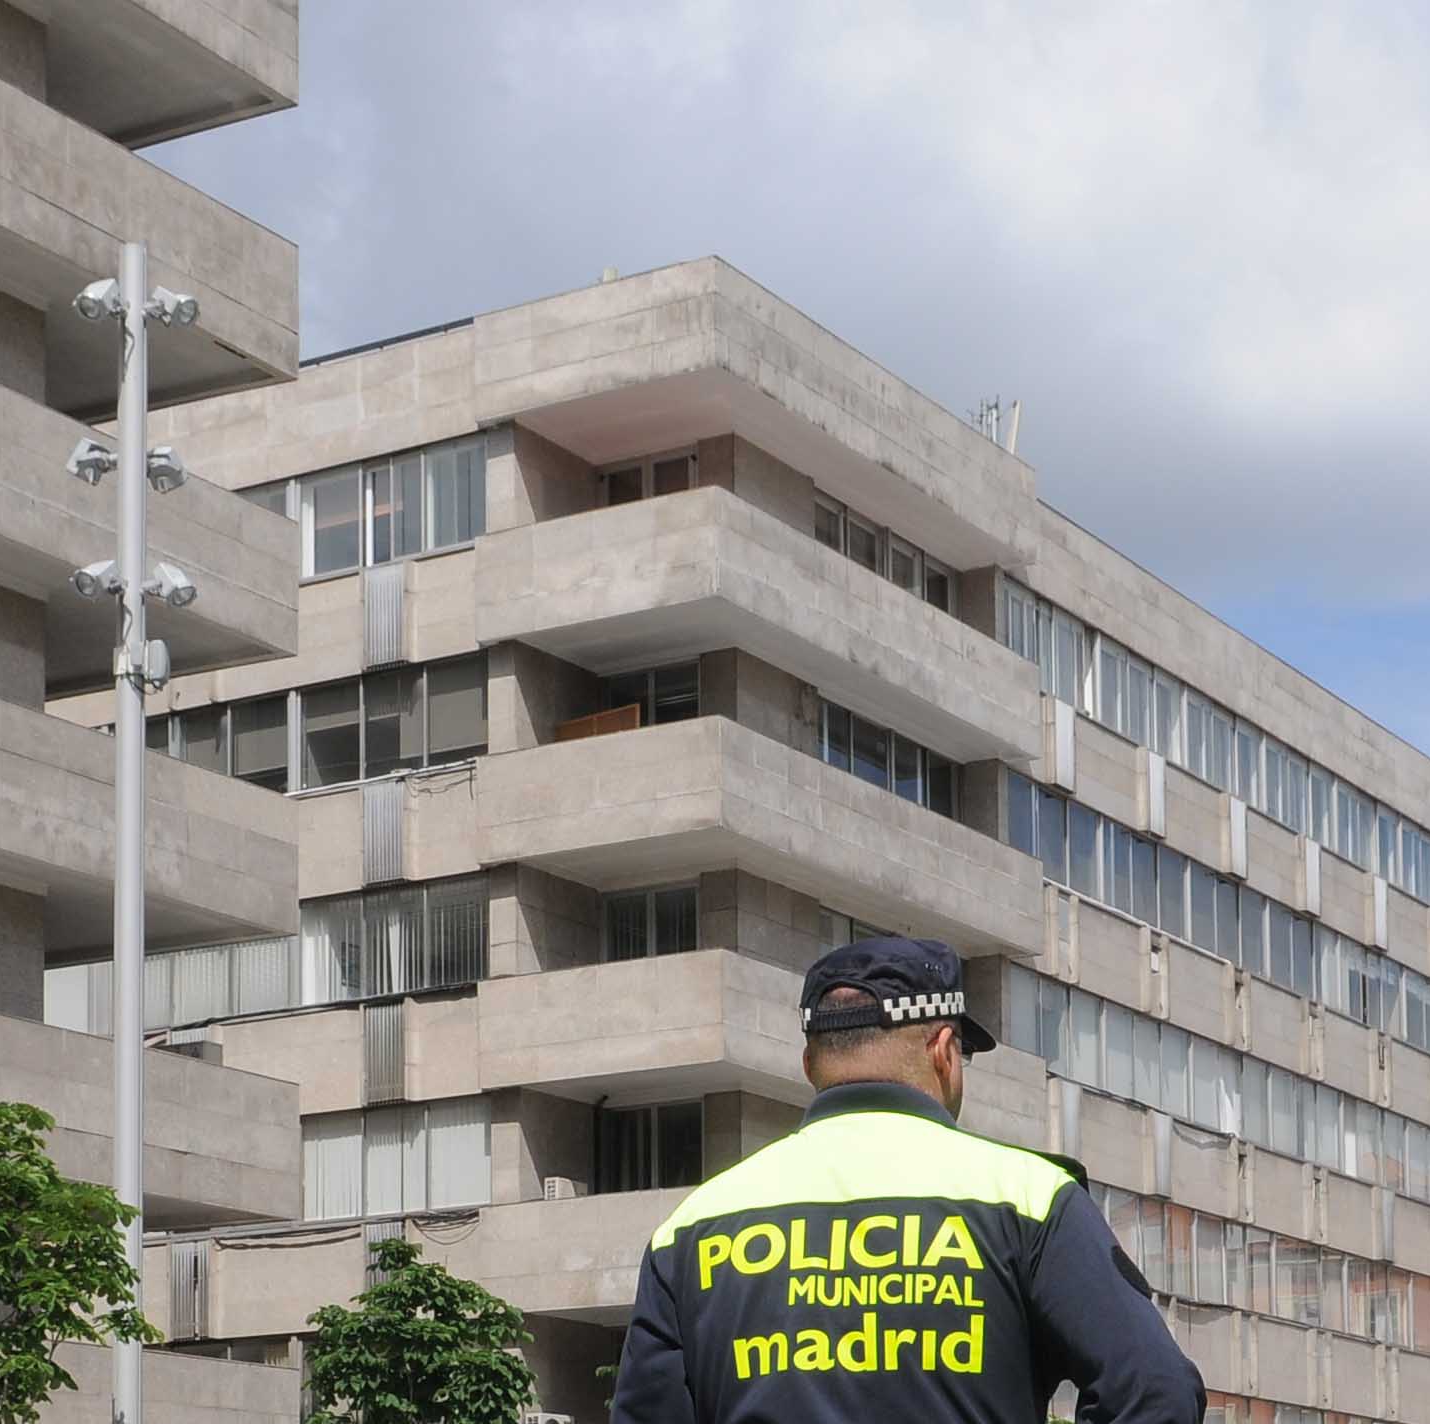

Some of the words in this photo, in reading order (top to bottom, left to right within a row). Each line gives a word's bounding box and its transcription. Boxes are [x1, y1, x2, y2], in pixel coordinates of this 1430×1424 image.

[698, 1215, 985, 1290] POLICIA
[788, 1274, 985, 1307] MUNICIPAL
[733, 1312, 985, 1380] madrid
